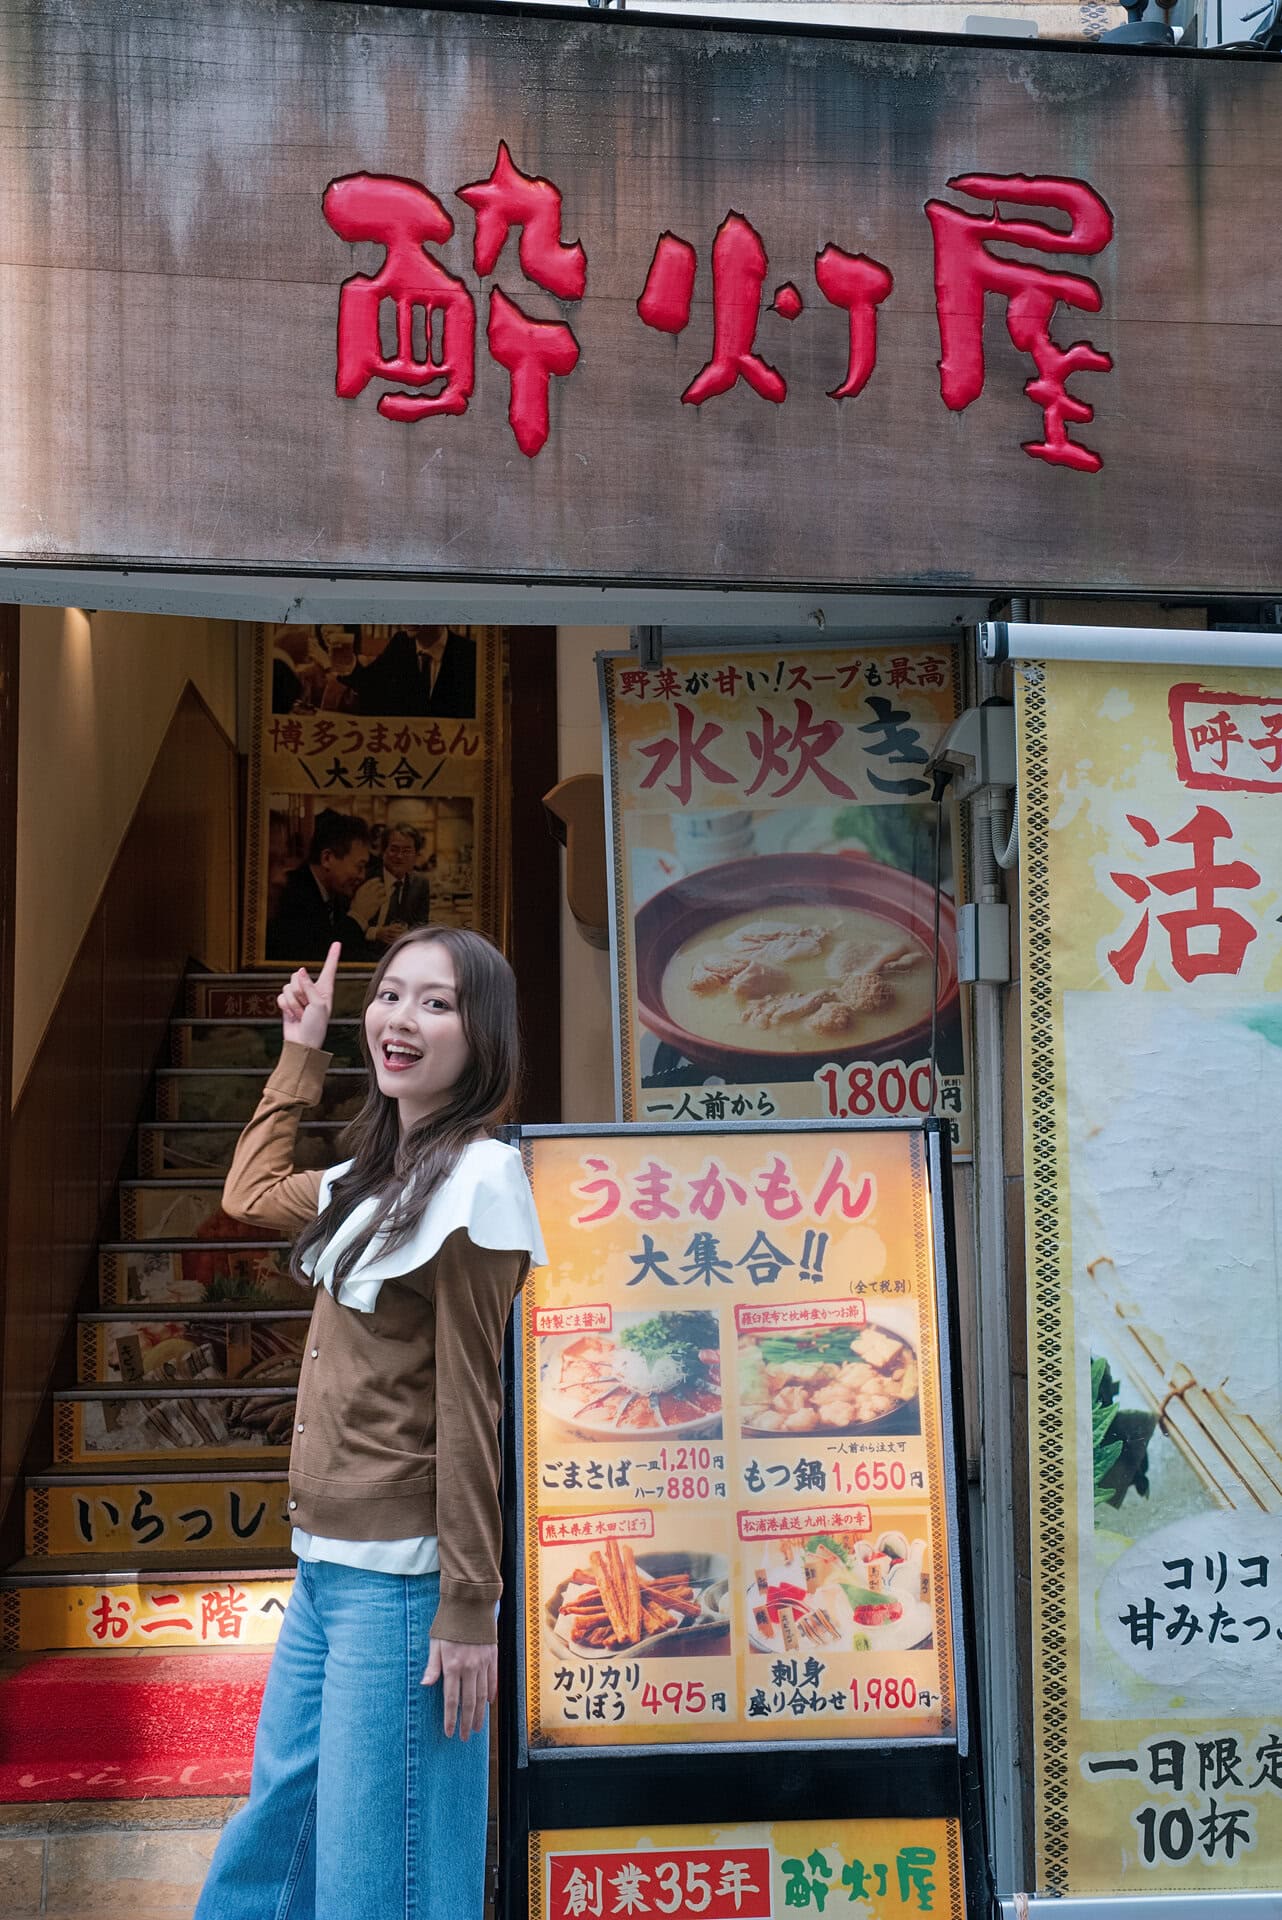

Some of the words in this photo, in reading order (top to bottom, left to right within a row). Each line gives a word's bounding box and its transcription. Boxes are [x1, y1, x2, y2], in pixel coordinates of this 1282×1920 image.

[619, 656, 947, 700] 野菜が甘い!スープも最高
[268, 719, 478, 757] 博多うまかもん
[637, 695, 930, 806] 水炊き
[1107, 805, 1282, 985] 活
[646, 1090, 775, 1120] 一人前から
[577, 1156, 872, 1223] うまかもん
[827, 1441, 907, 1454] 一人前から注文可
[542, 1459, 632, 1490] ごまさば
[744, 1458, 826, 1493] もつ鍋
[77, 1490, 291, 1543] いらっし
[1163, 1551, 1282, 1594] コリコ
[1119, 1597, 1282, 1651] 甘みたっ
[554, 1663, 640, 1691] カリカリ
[771, 1656, 826, 1688] 刺身
[564, 1692, 625, 1721] ごぼう
[748, 1689, 847, 1717] 盛り合わせ
[1088, 1734, 1282, 1791] 一日限定
[1136, 1797, 1250, 1863] 10杯
[563, 1859, 760, 1917] 創業35年
